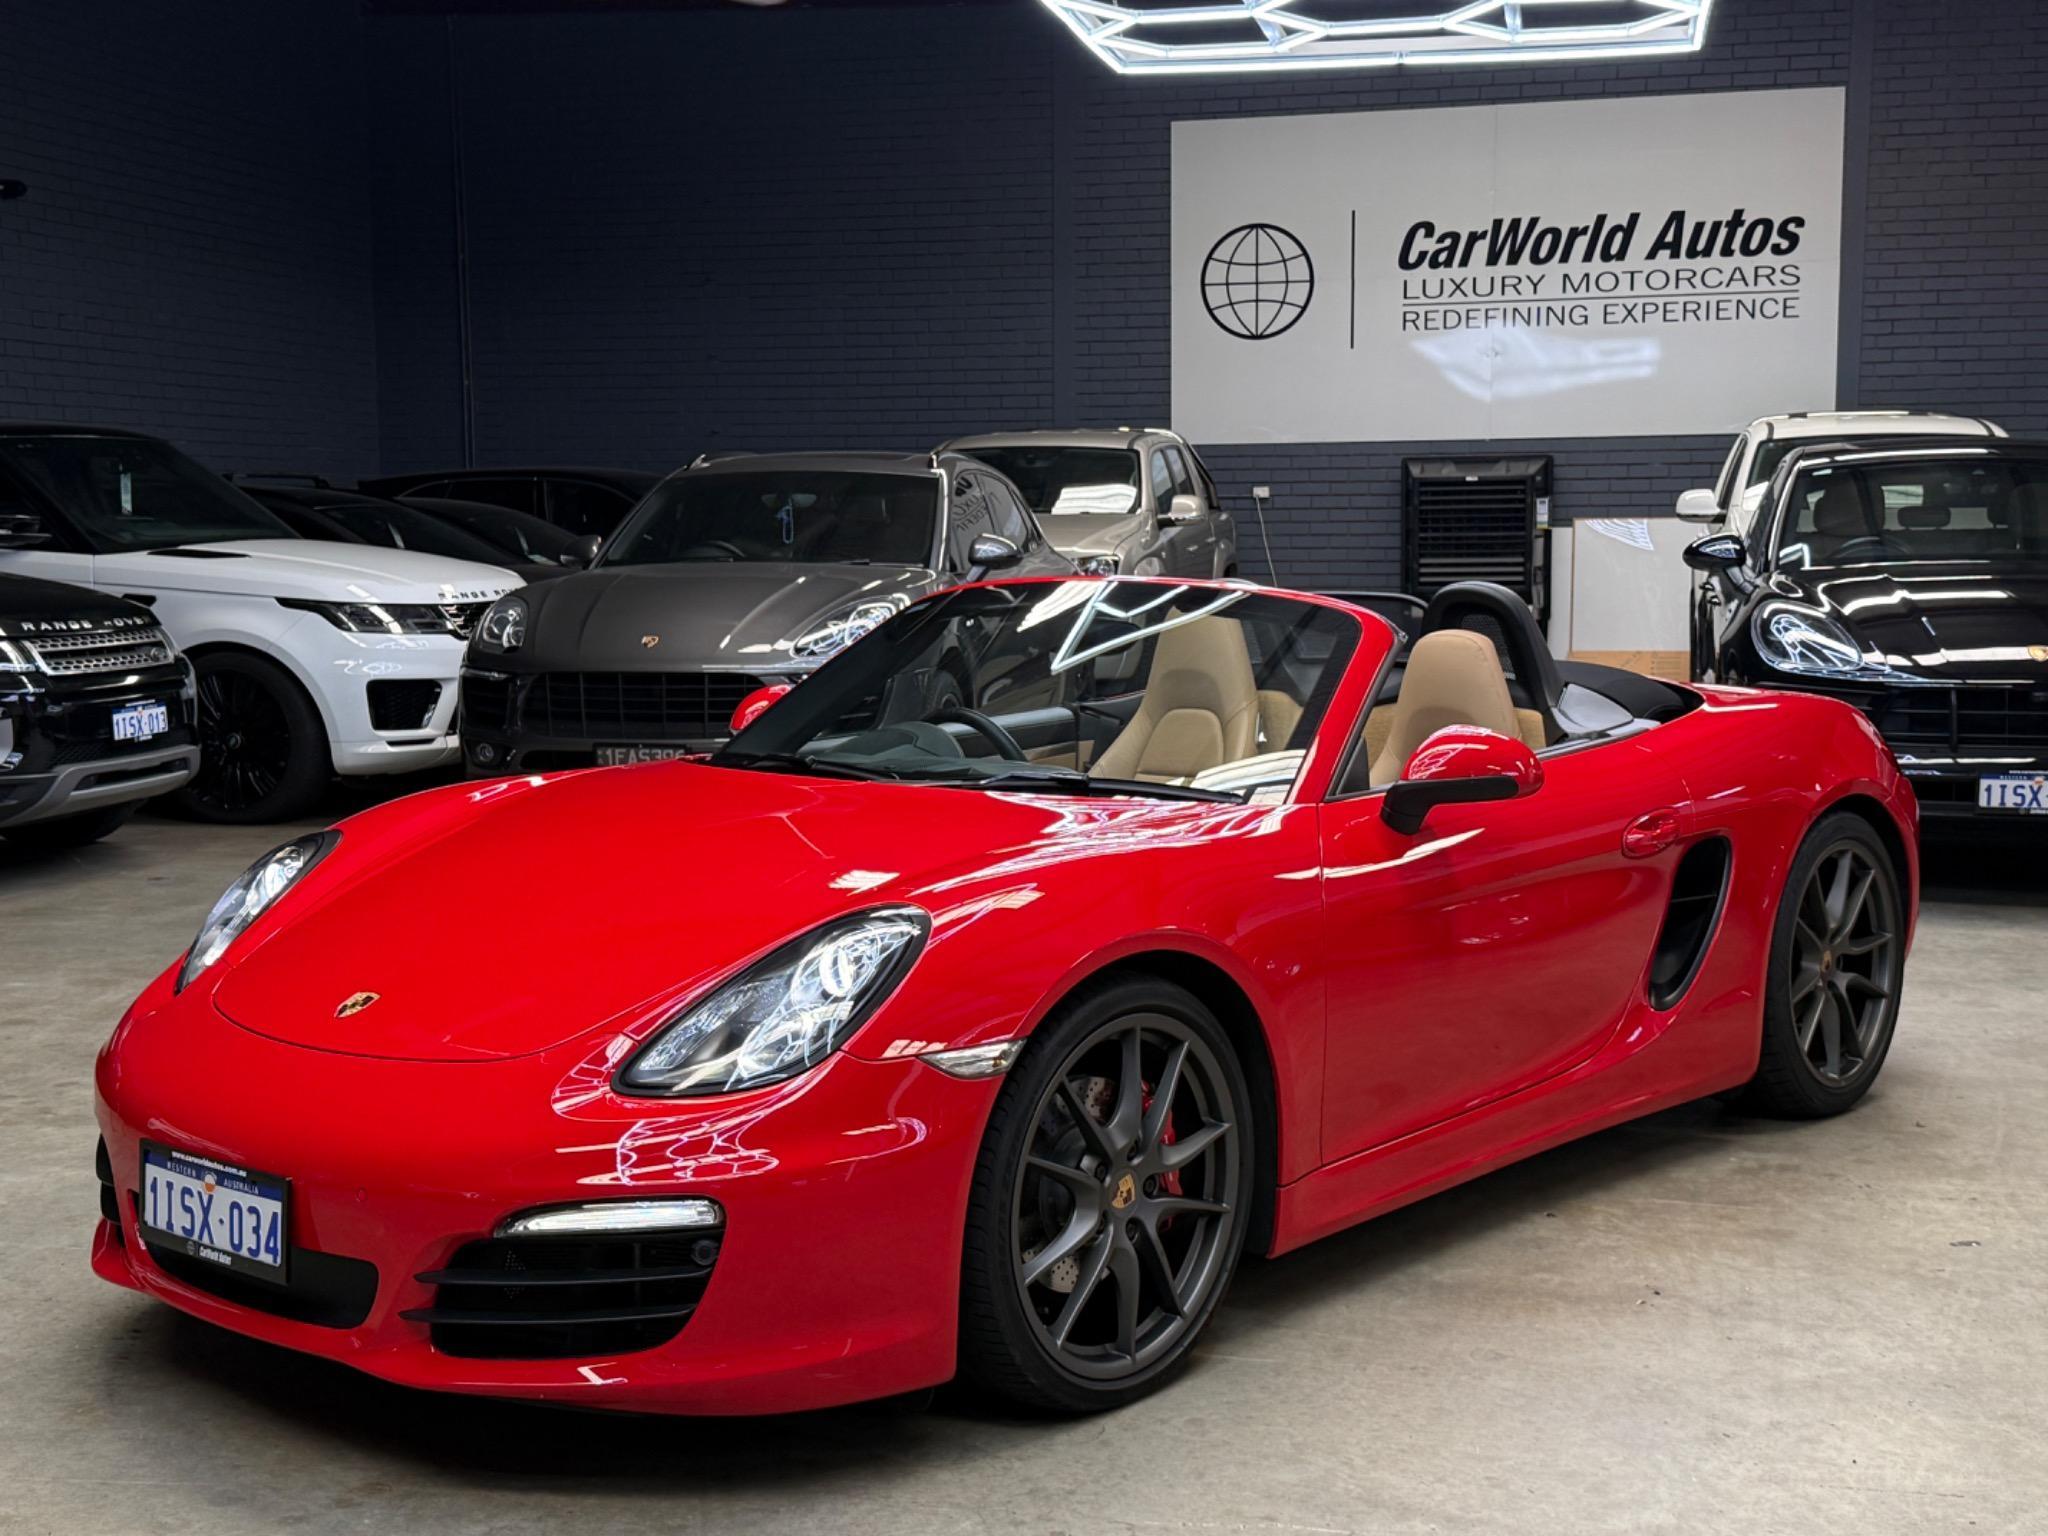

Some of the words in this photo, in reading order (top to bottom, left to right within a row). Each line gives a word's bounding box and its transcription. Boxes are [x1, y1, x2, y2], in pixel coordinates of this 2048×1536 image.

[1398, 212, 1641, 271] CarWorld
[1644, 208, 1806, 260] Autos
[1403, 273, 1546, 299] LUXURY
[1562, 264, 1801, 295] MOTORCARS
[1402, 304, 1589, 331] REDEFINING
[1603, 296, 1800, 325] EXPERIENCE
[21, 620, 93, 631] RANGE
[167, 1161, 197, 1178] WESTERN
[223, 1178, 260, 1195] AUSTRALIA
